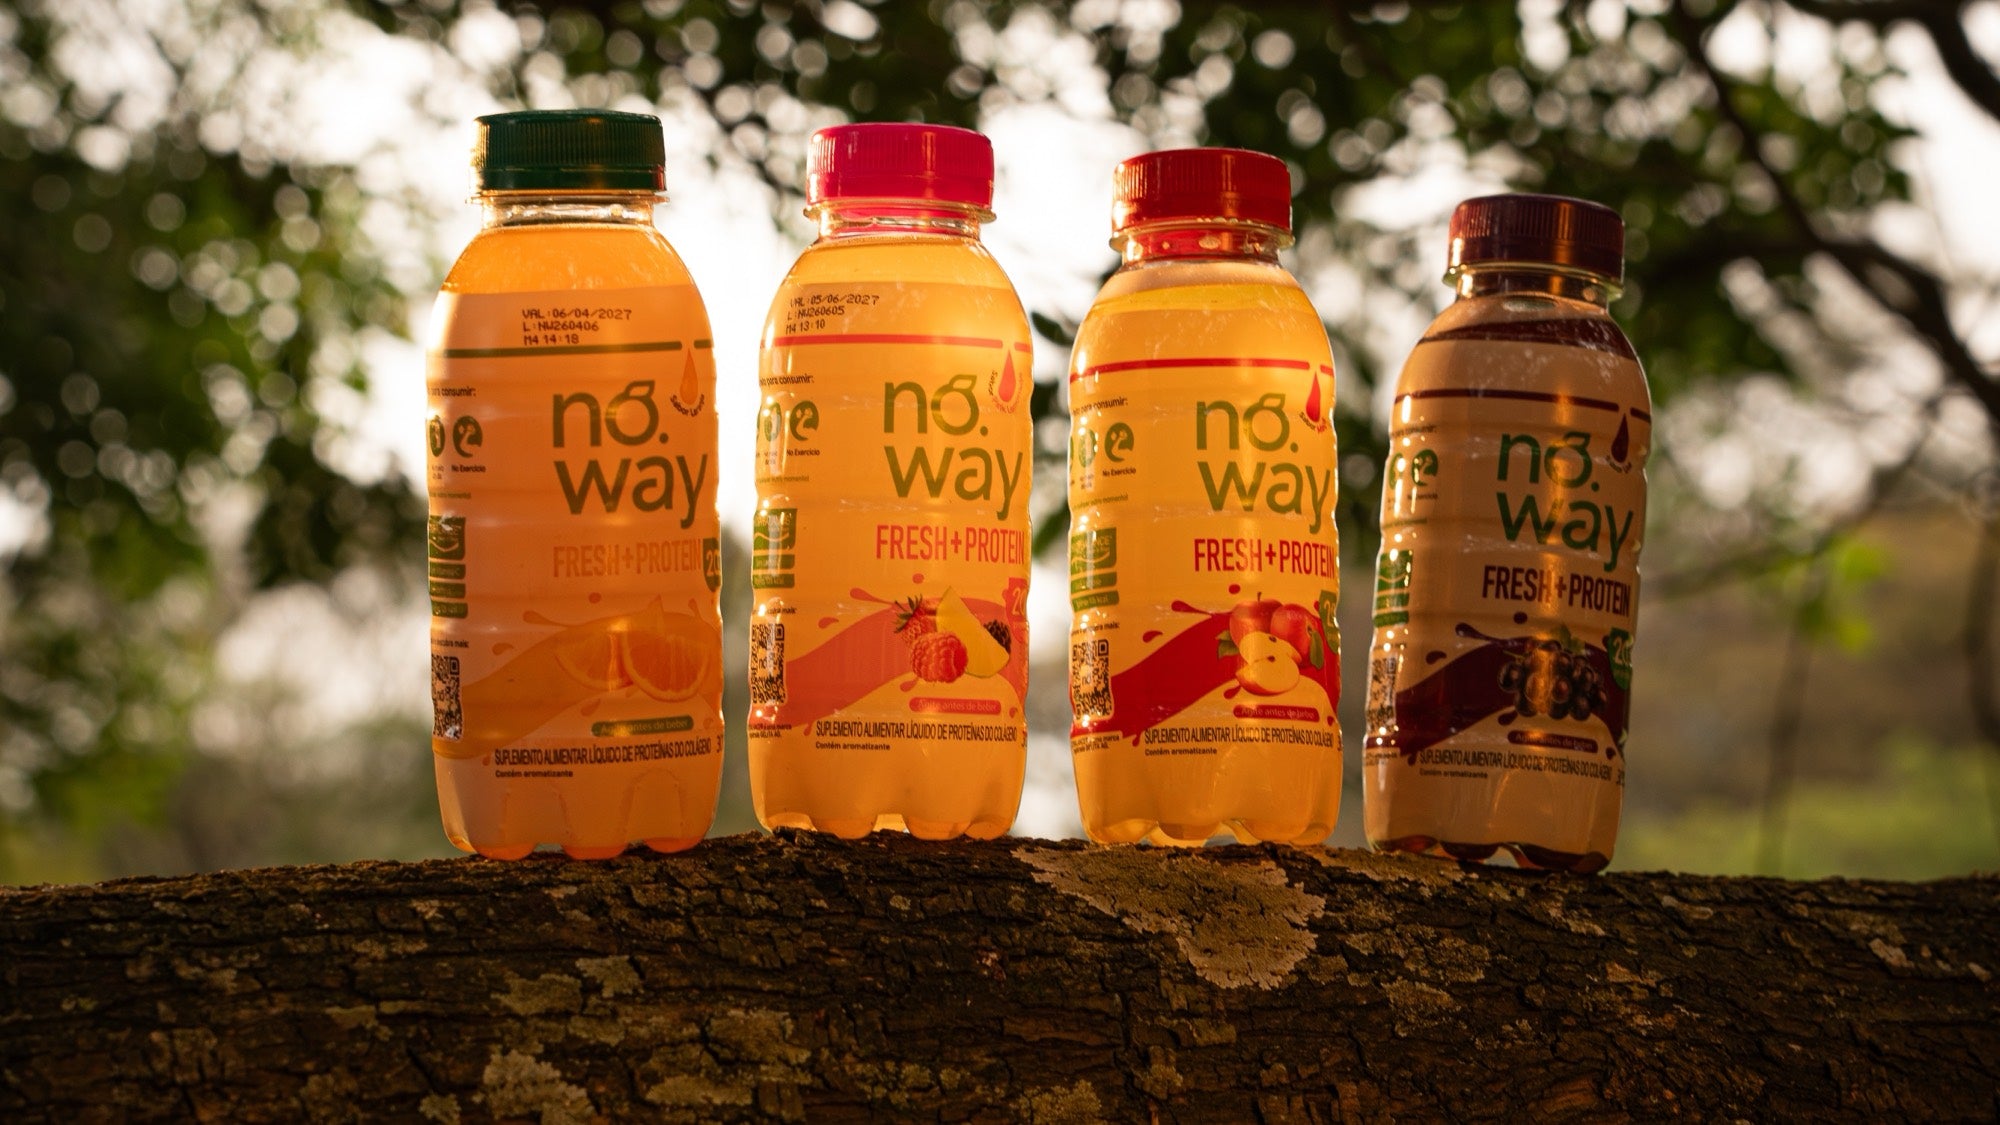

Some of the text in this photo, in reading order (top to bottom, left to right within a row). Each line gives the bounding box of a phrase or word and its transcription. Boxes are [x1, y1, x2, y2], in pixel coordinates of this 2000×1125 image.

[780, 373, 815, 385] consumir:
[553, 453, 708, 529] way
[883, 445, 1024, 521] way
[1197, 461, 1331, 535] way
[876, 523, 1026, 565] FRESH+PROTEIN
[1496, 492, 1634, 573] way
[1193, 538, 1336, 580] FRESH+PROTEIN
[815, 720, 863, 737] SUPLEMENTO
[864, 721, 906, 739] ALIMENTAR
[906, 720, 937, 739] LÍQUIDO
[937, 723, 948, 740] DE
[948, 722, 985, 741] PROTEÍNAS
[985, 725, 994, 742] DO
[1144, 727, 1190, 744] SUPLEMENTO
[1191, 726, 1230, 743] ALIMENTAR
[1261, 726, 1271, 743] DE
[1271, 724, 1305, 745] PROTEÍNAS
[1305, 729, 1314, 746] DO
[495, 748, 543, 765] SUPLEMENTO
[544, 747, 588, 765] ALIMENTAR
[589, 744, 620, 764] LÍQUIDO
[622, 746, 634, 762] DE
[634, 740, 674, 761] PROTEÍNAS
[675, 742, 684, 758] DO
[815, 741, 891, 751] Contém aromatizante
[1144, 746, 1218, 757] Contém aromatizante
[495, 769, 574, 778] Contém aromatizante
[1419, 749, 1461, 765] SUPLEMENTO
[1462, 751, 1502, 768] ALIMENTAR
[1532, 753, 1543, 773] DE
[1580, 760, 1589, 778] DO
[1443, 770, 1488, 779] aromatizante
